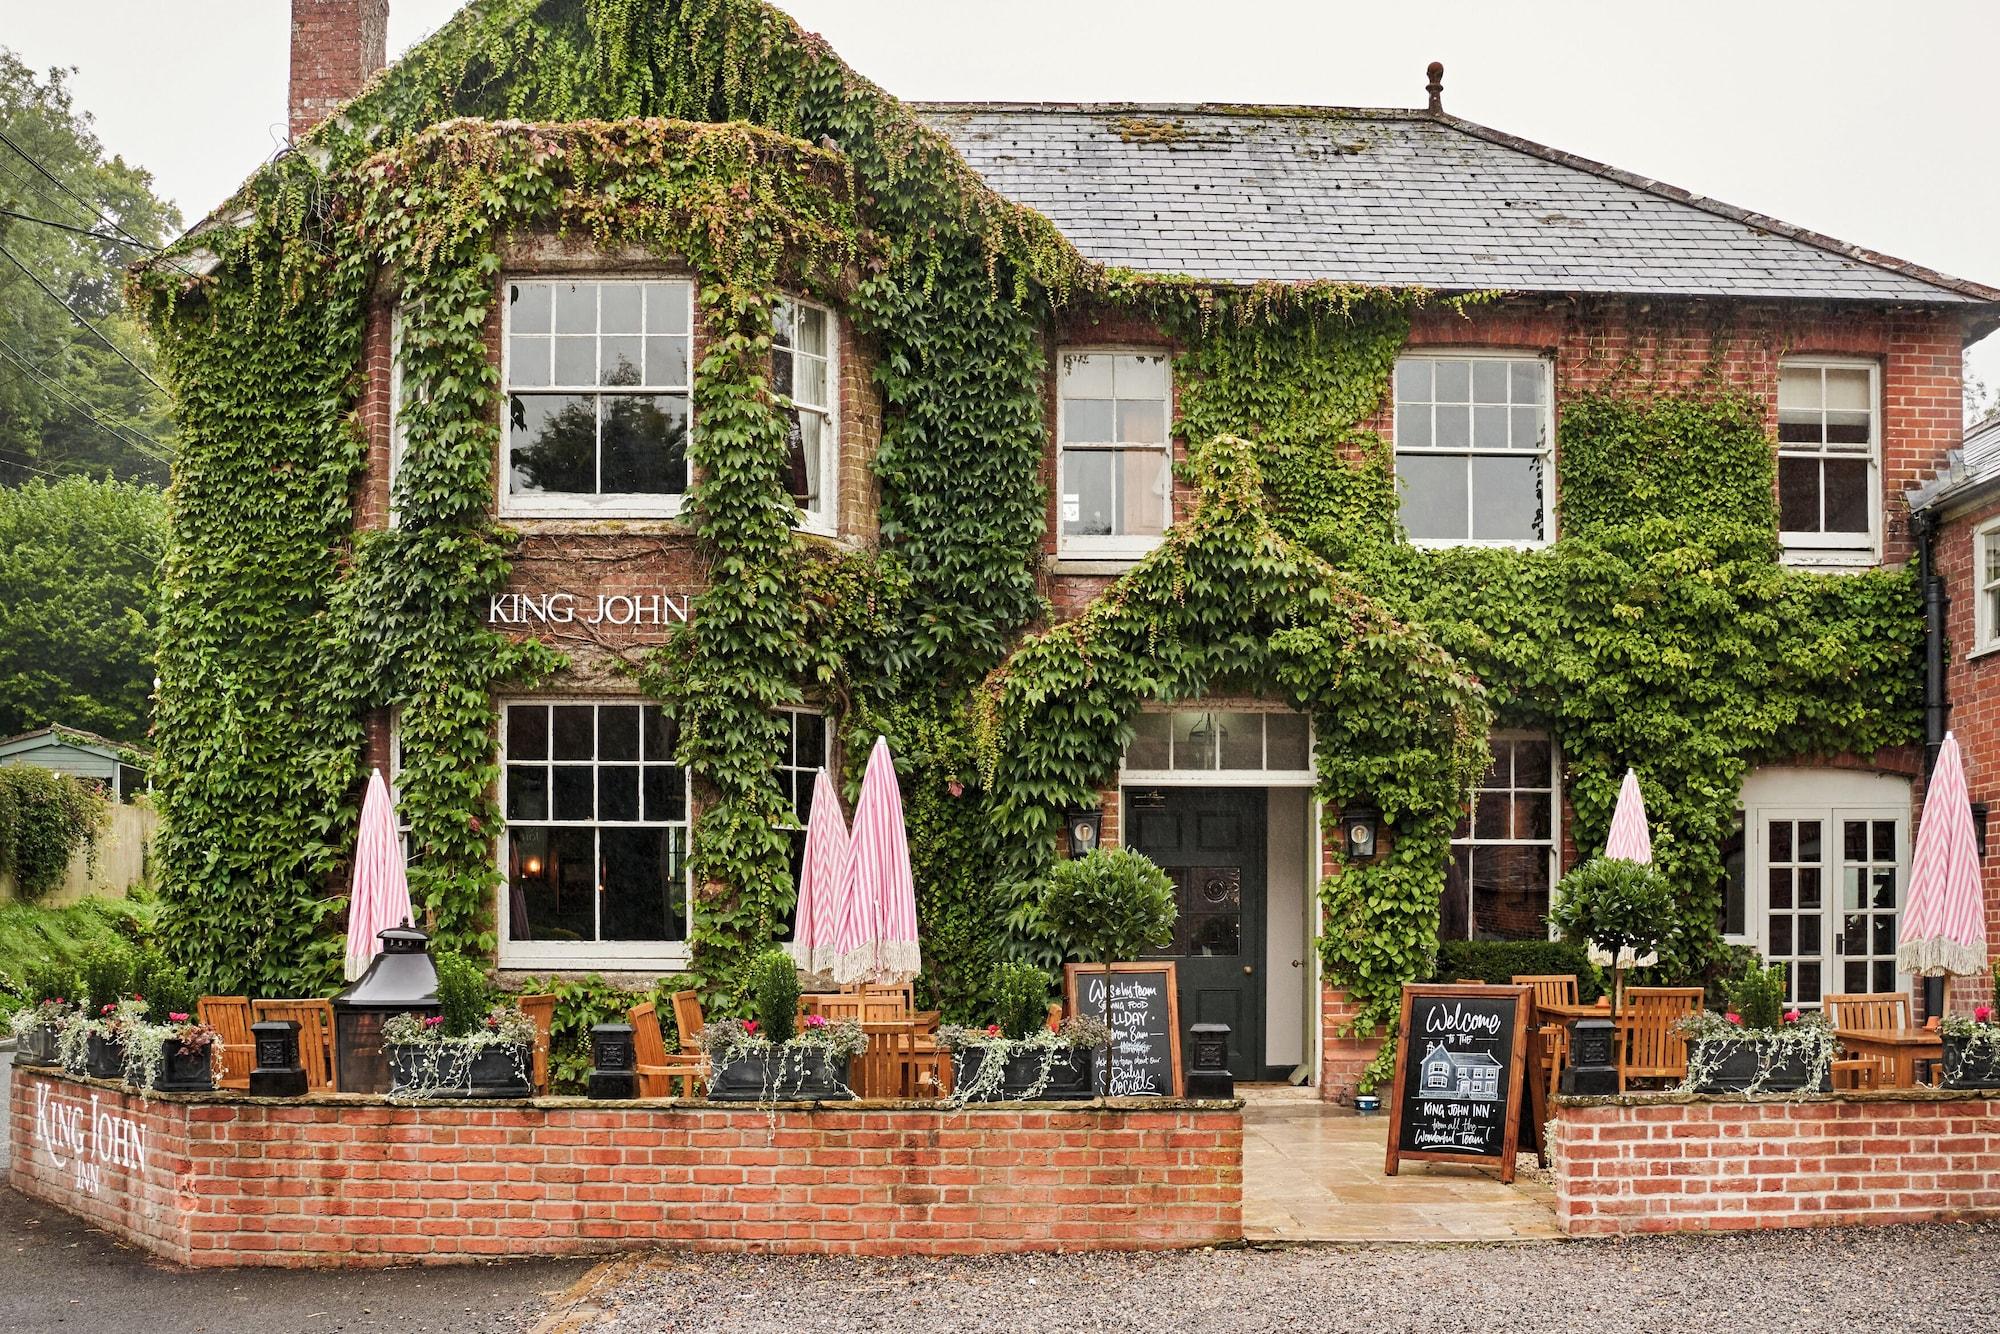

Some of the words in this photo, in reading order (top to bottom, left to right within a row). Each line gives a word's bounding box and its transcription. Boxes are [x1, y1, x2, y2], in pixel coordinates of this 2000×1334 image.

[488, 593, 574, 623] KING
[587, 594, 690, 624] JOHN
[1132, 981, 1157, 998] team
[1127, 1001, 1149, 1010] FOOD
[1426, 1003, 1501, 1034] Welcome
[1456, 1034, 1474, 1045] THE
[1111, 1064, 1140, 1081] Daily
[1423, 1102, 1445, 1118] KING
[1447, 1104, 1469, 1116] JOHN
[1472, 1104, 1490, 1118] INN
[36, 1082, 84, 1168] KING
[91, 1094, 146, 1173] JOHN
[1414, 1129, 1455, 1145] Wonderful
[76, 1160, 100, 1194] INN
